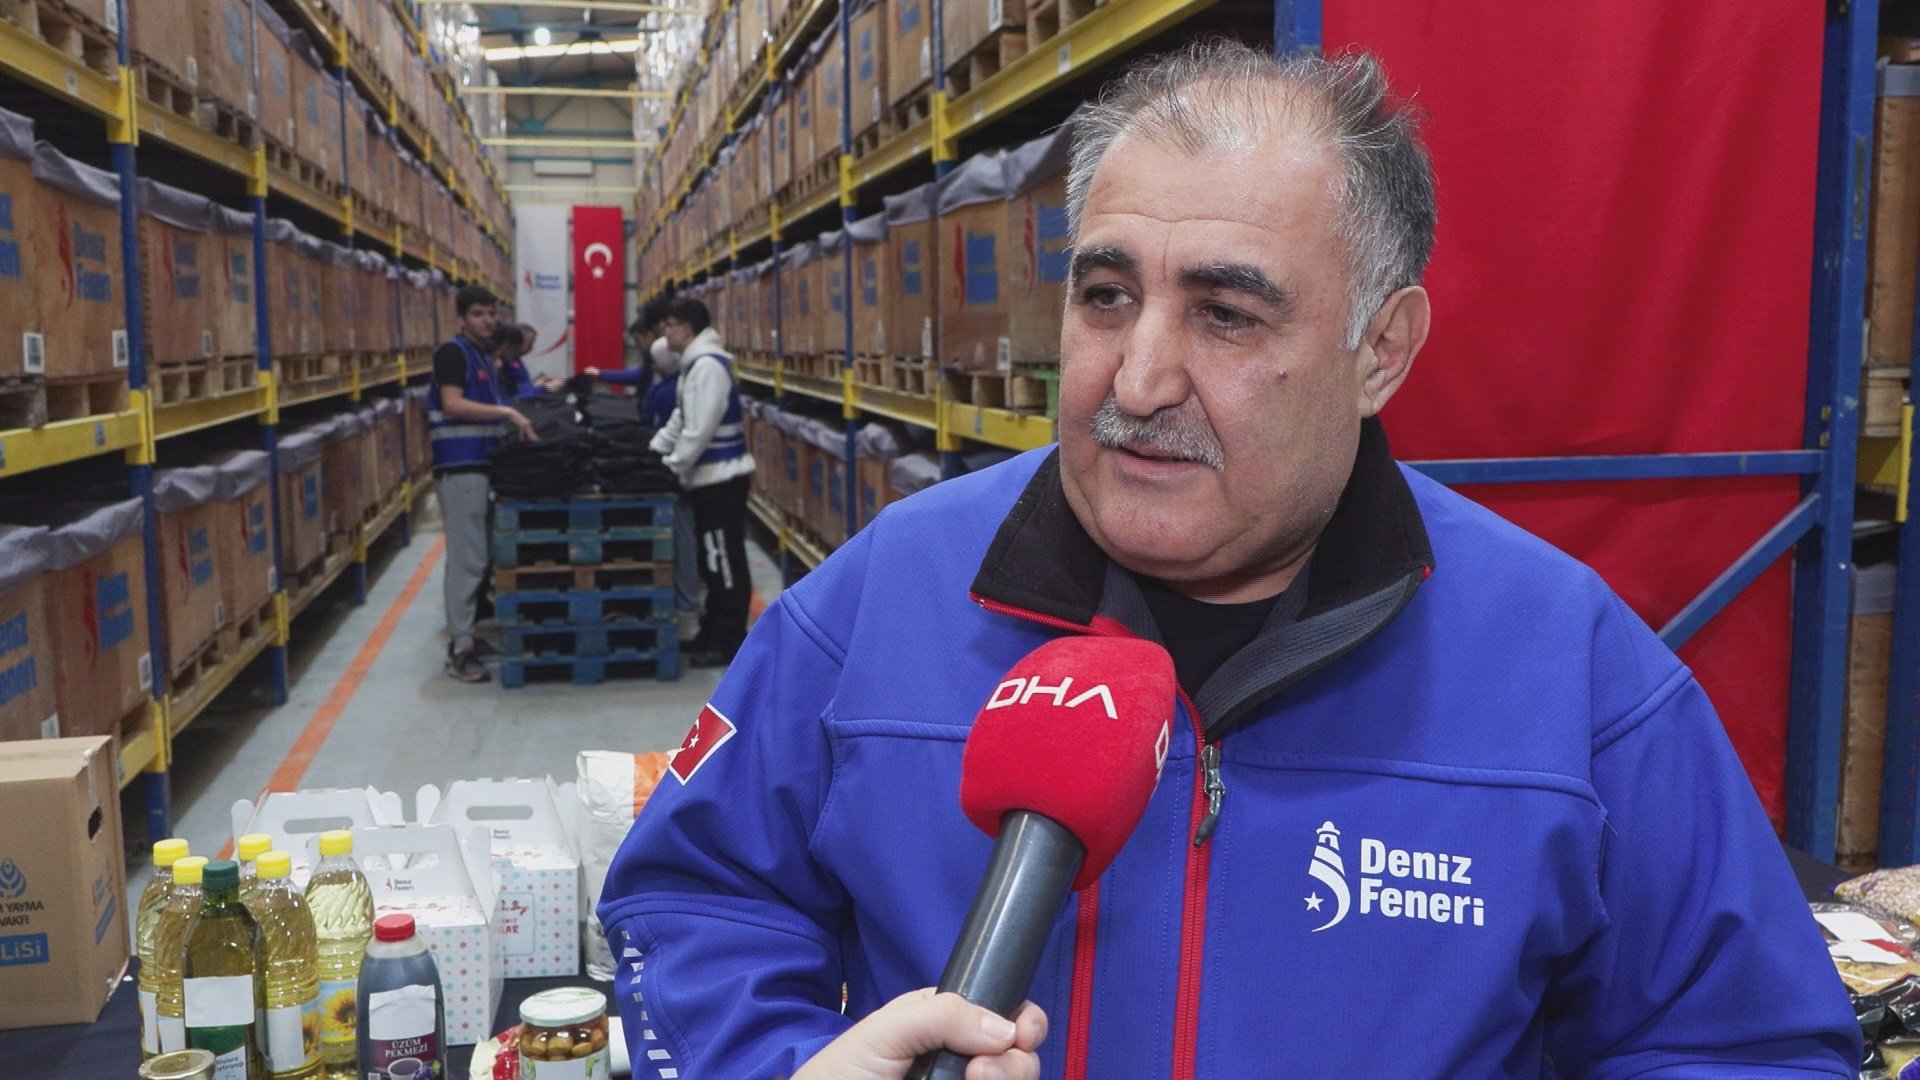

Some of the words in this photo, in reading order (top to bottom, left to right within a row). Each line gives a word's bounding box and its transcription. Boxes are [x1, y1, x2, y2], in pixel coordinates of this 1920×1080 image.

[985, 675, 1119, 720] DHA
[1360, 838, 1472, 885] Deniz
[6, 900, 44, 913] YAYMA
[1359, 877, 1484, 927] Feneri
[384, 1043, 428, 1057] PEKMEZİ
[391, 1038, 422, 1049] ÜZÜM
